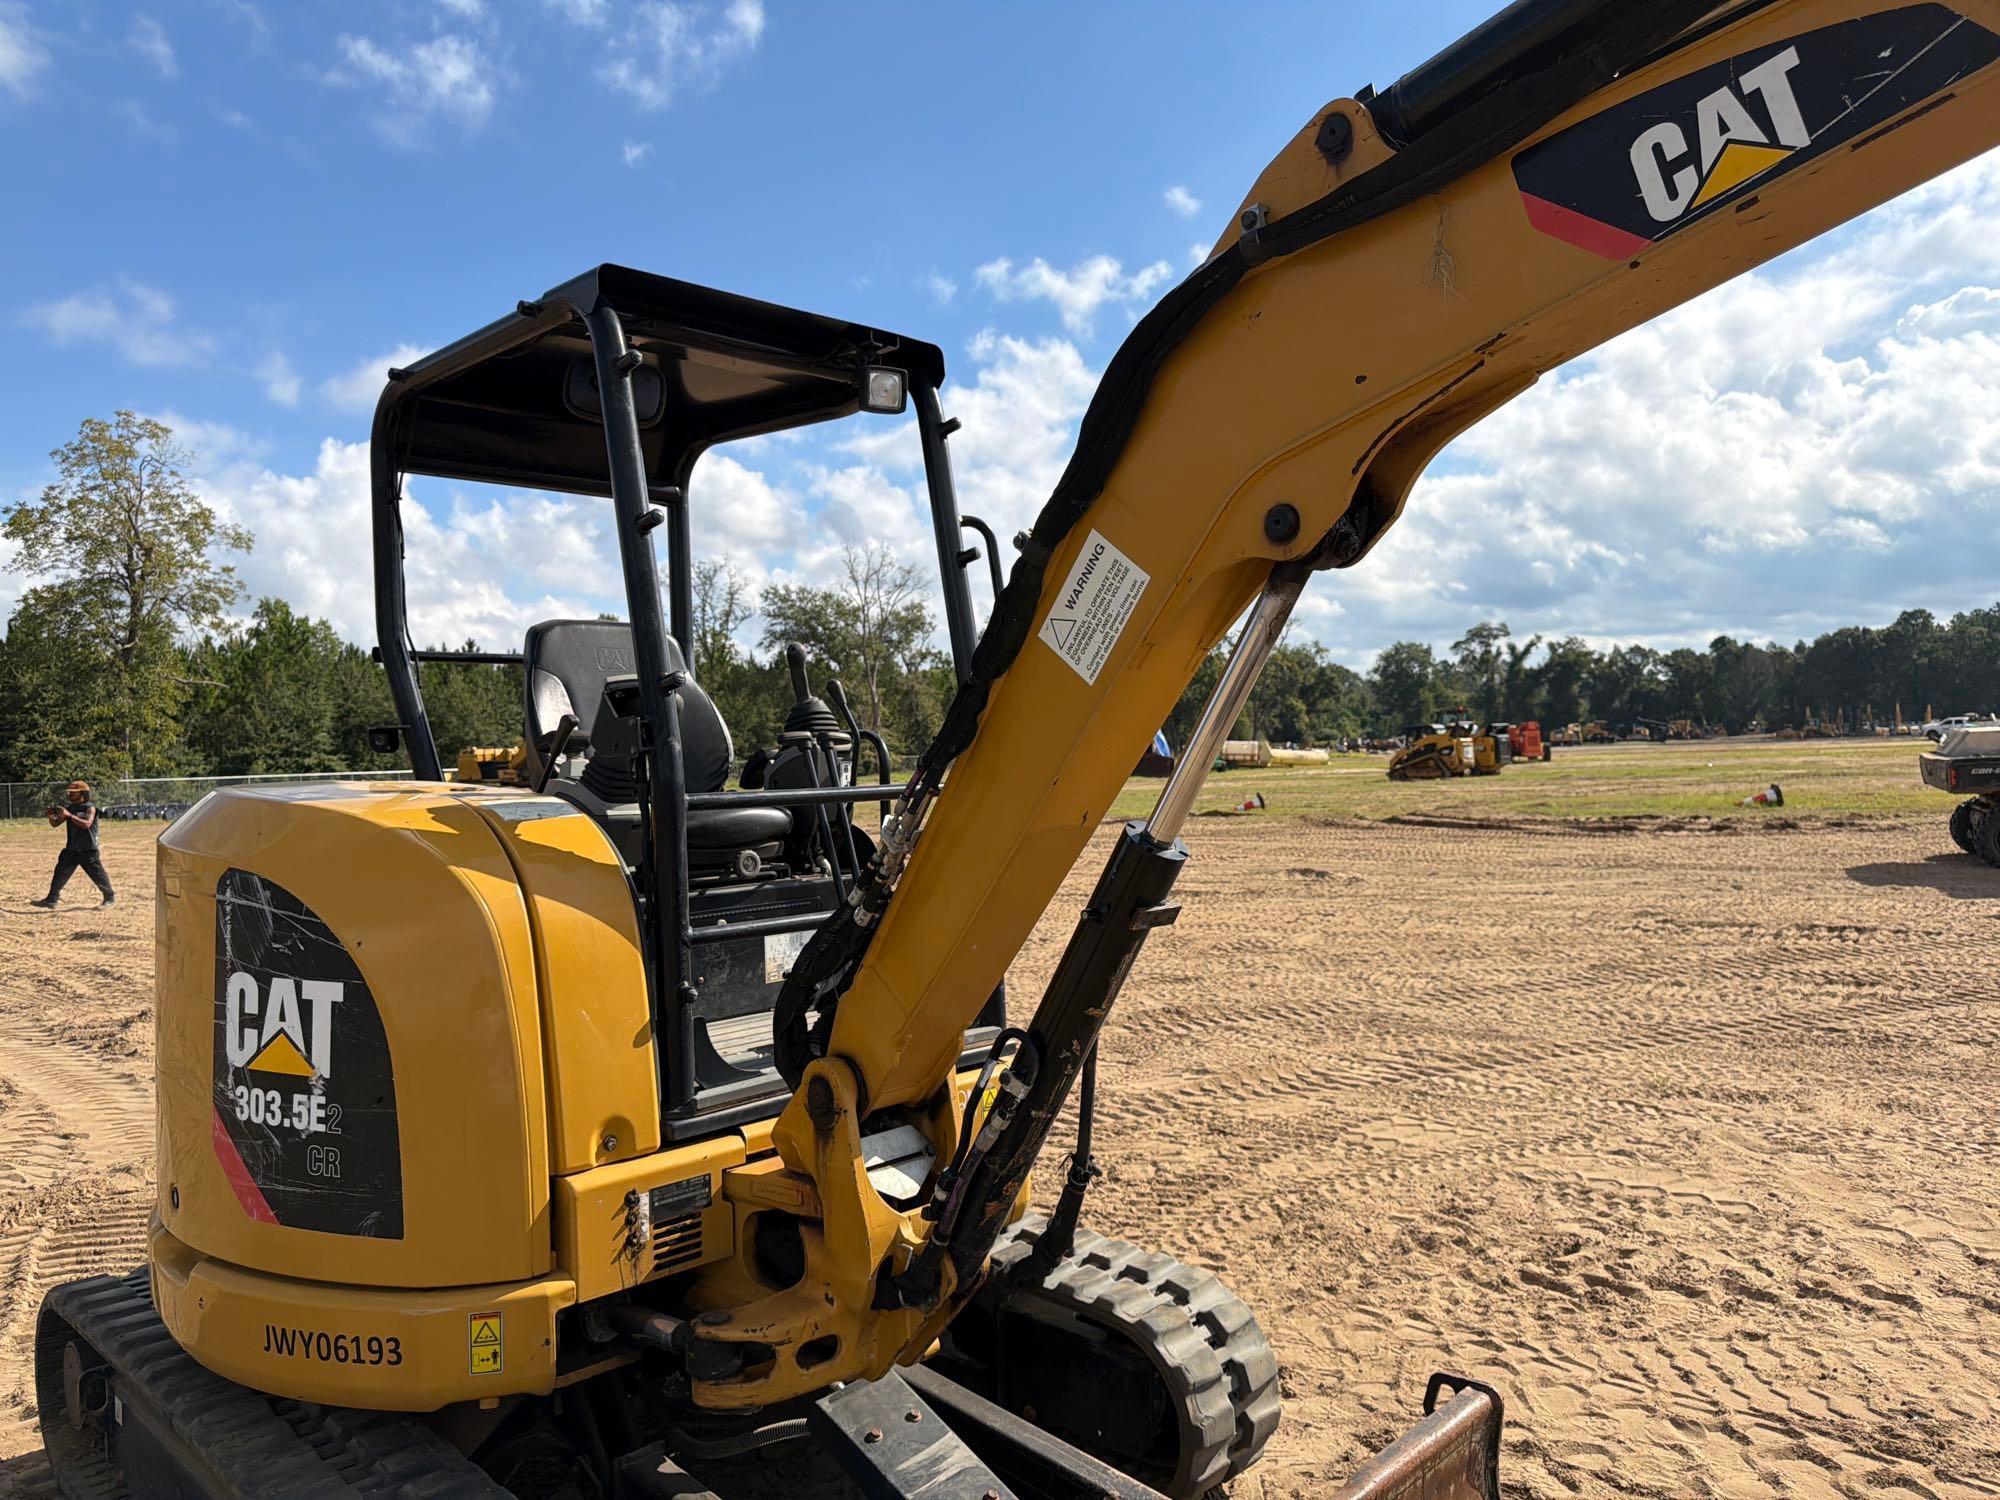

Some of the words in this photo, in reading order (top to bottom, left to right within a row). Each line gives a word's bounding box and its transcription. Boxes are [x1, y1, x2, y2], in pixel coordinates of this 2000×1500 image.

[1629, 44, 1811, 222] CAT
[1064, 540, 1105, 612] WARNING
[1064, 616, 1088, 656] UNLAWFUL
[1084, 606, 1093, 619] TO
[1089, 573, 1111, 609] OPERATE
[1107, 557, 1119, 575] THIS
[1069, 619, 1094, 661] EQUIPMENT
[1090, 594, 1107, 621] WITHIN
[1103, 580, 1114, 596] TEN
[1111, 561, 1125, 582] FEET
[1073, 653, 1083, 666] OF
[1079, 615, 1103, 656] OVERHEAD
[1099, 564, 1131, 618] HIGH-VOLTAGE
[1085, 643, 1102, 671] Contact
[1099, 629, 1110, 646] with
[1108, 608, 1123, 632] power
[1118, 591, 1131, 610] lines
[1128, 578, 1138, 593] can
[1087, 659, 1101, 680] result
[1097, 652, 1105, 662] in
[1102, 632, 1116, 654] death
[1113, 625, 1120, 634] or
[1117, 599, 1134, 626] serious
[1098, 611, 1113, 634] LINES
[226, 970, 344, 1079] CAT
[234, 1085, 342, 1135] 303.5E2
[306, 1144, 341, 1178] CR
[263, 1324, 403, 1366] JWY06193
